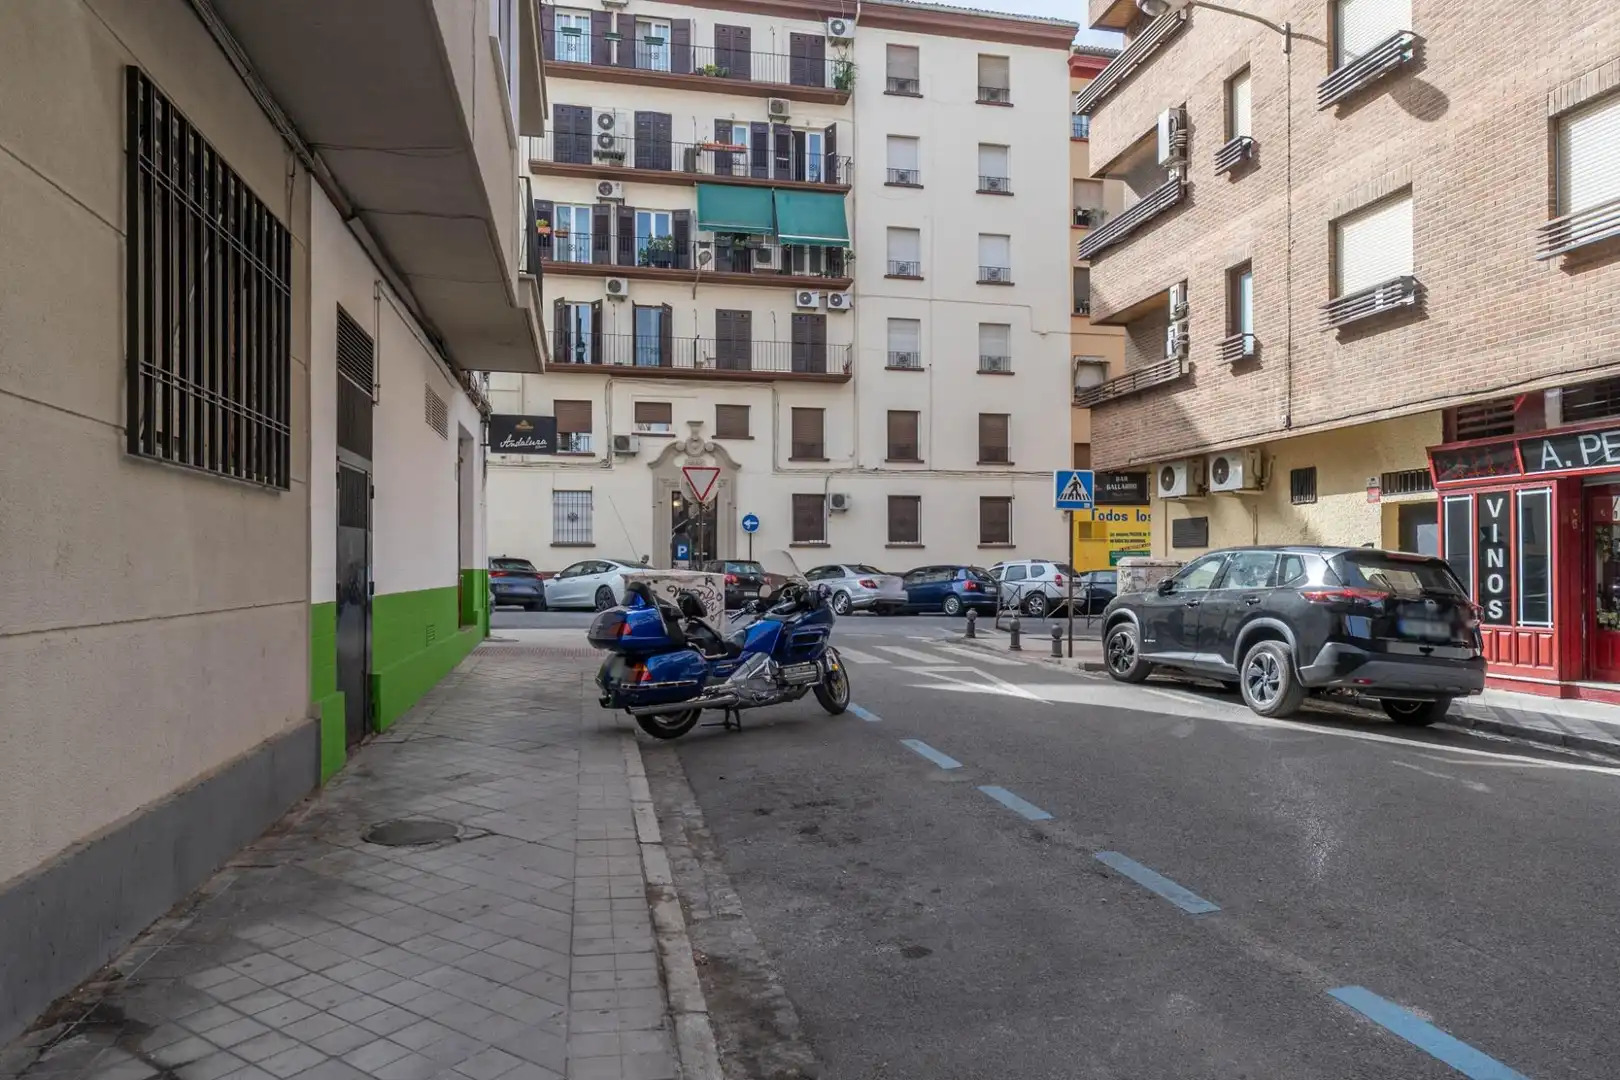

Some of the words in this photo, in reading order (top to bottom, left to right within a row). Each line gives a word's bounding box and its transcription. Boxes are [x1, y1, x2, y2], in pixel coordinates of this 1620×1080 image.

[500, 434, 547, 448] Andaluza
[1540, 439, 1572, 469] A.
[1091, 507, 1128, 521] Todos
[677, 545, 688, 557] P
[1486, 498, 1504, 619] VINOS
